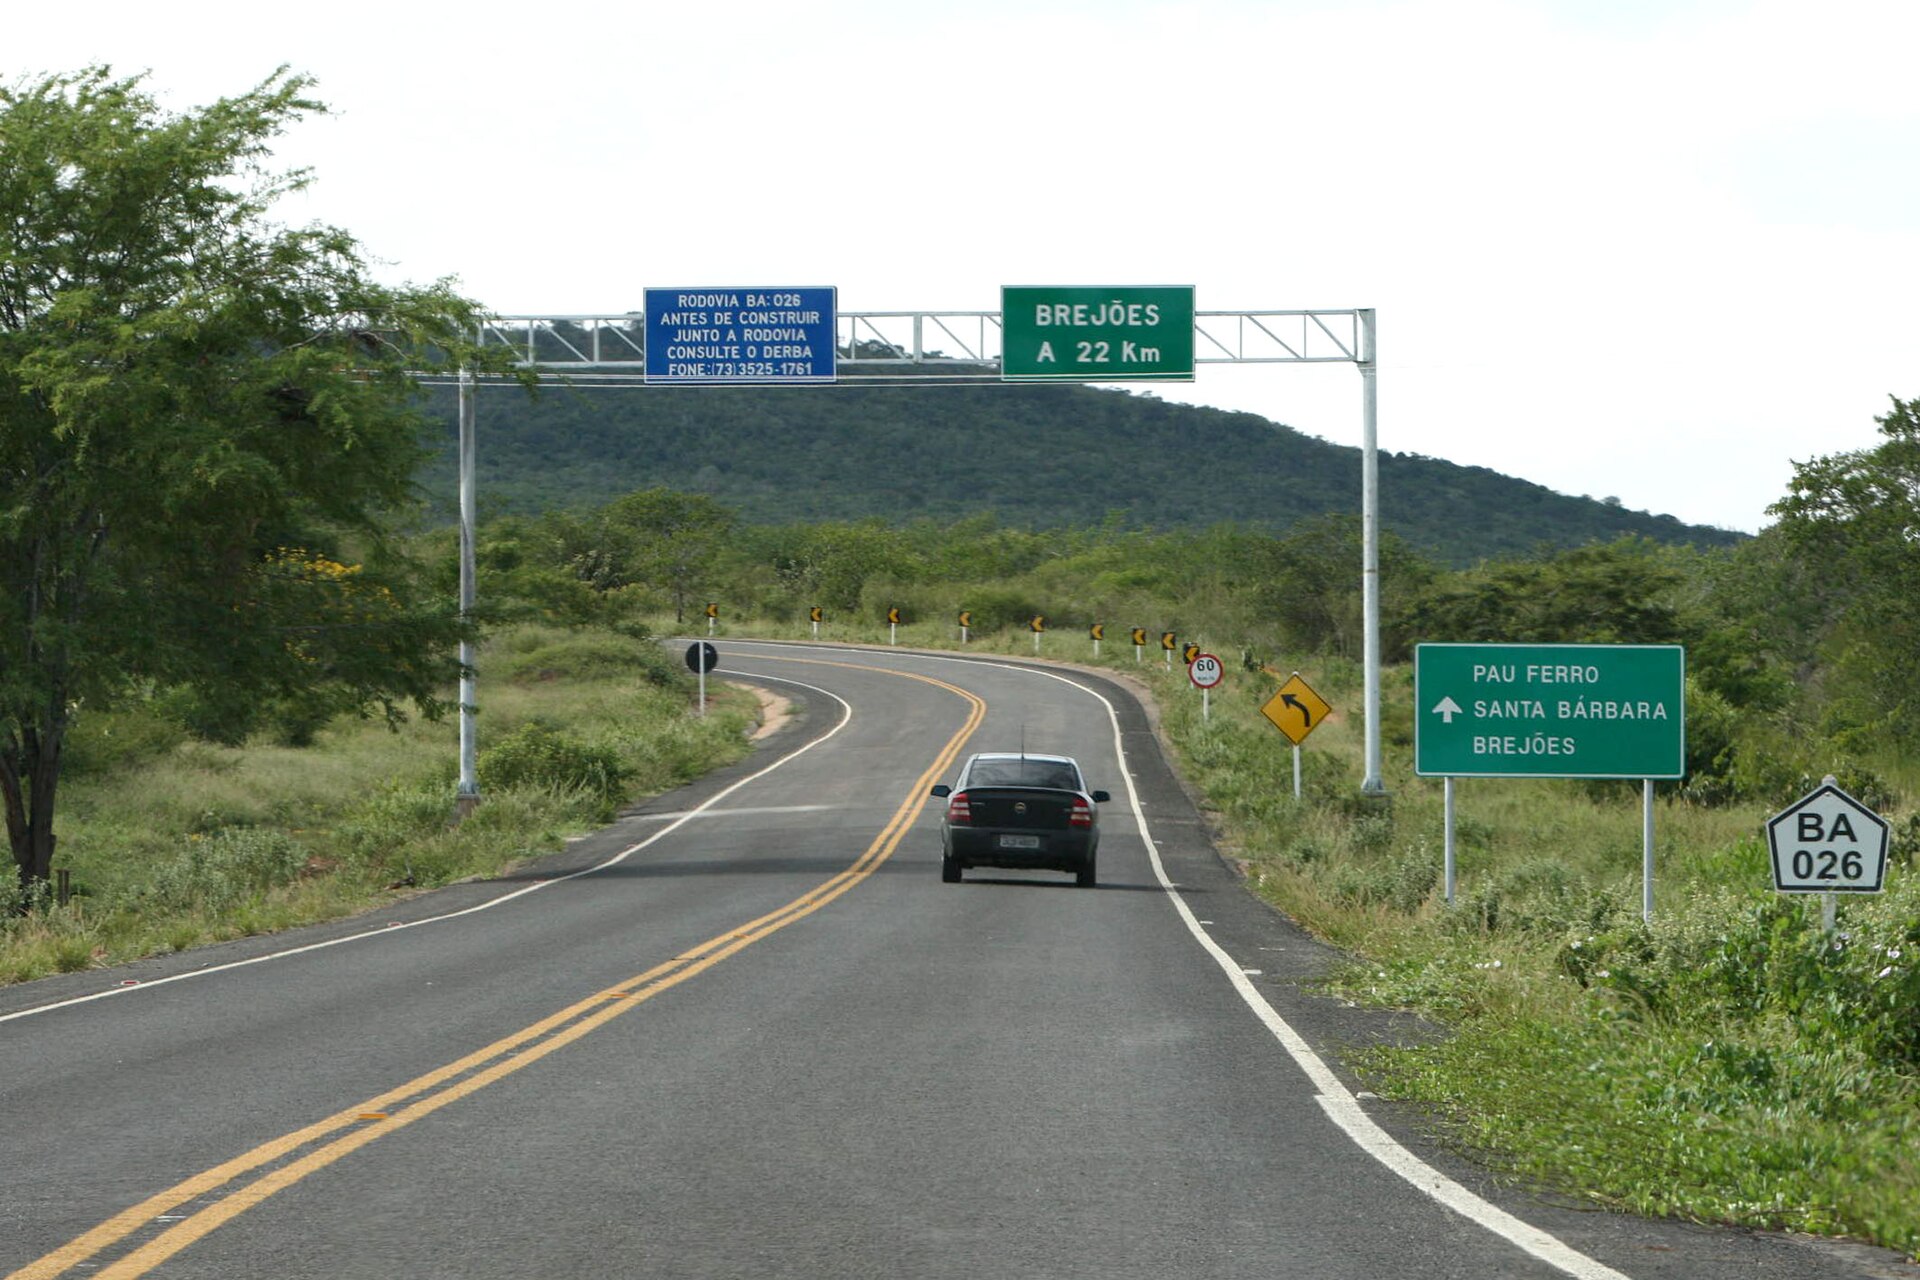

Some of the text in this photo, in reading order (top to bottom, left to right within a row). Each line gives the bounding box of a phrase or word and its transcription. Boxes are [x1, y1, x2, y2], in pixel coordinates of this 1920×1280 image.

[678, 295, 739, 307] RODOVIA
[660, 312, 820, 325] ANTES DE CONSTRUIR
[1035, 300, 1160, 326] BREJÕES
[673, 328, 807, 342] JUNTO A RODOVIA
[667, 345, 813, 359] CONSULTE O DERBA
[1036, 341, 1161, 363] A 22 Km
[1197, 659, 1214, 671] 60
[1473, 665, 1599, 683] PAU FERRO
[1474, 695, 1667, 720] SANTA BÁRBARA
[1473, 733, 1576, 755] BREJÕES
[1797, 813, 1858, 842] BA
[1792, 850, 1863, 880] 026
